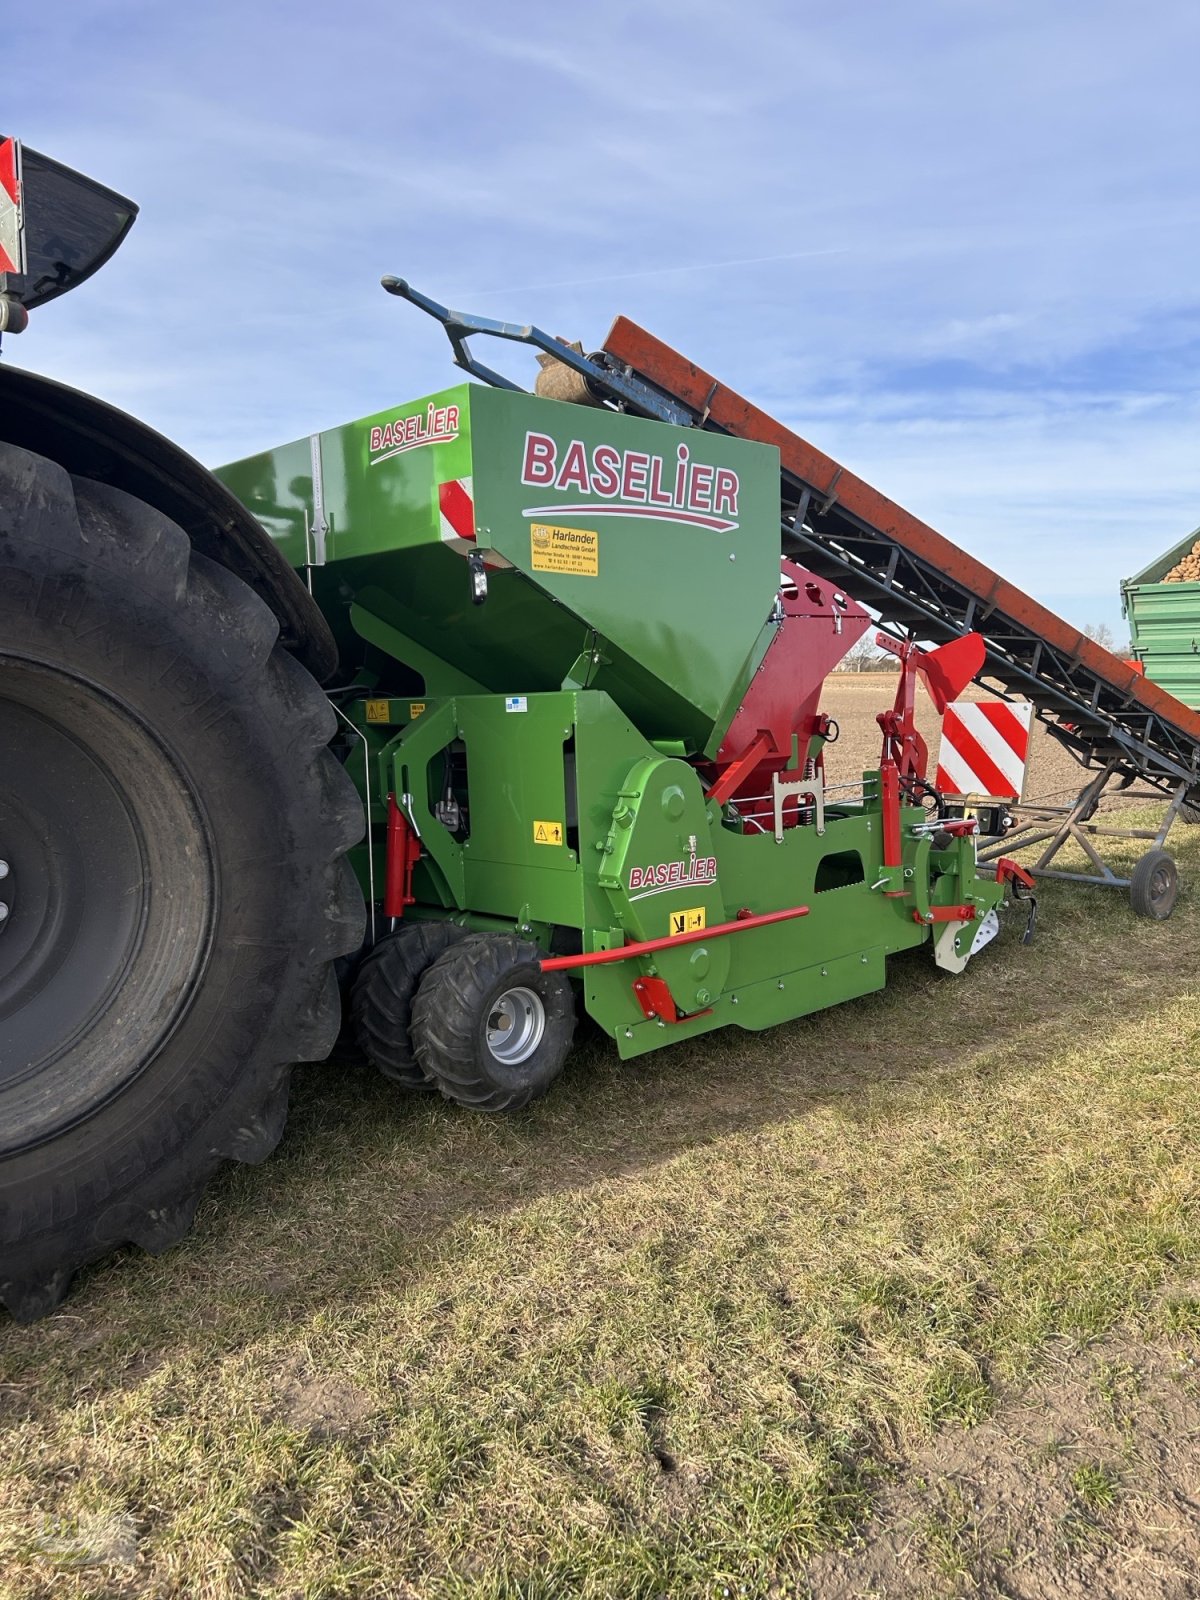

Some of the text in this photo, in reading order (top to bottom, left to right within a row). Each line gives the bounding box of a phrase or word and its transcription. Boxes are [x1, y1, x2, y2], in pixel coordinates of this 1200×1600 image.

[552, 529, 595, 545] Harlander
[551, 543, 596, 553] Landtechnik GmbH
